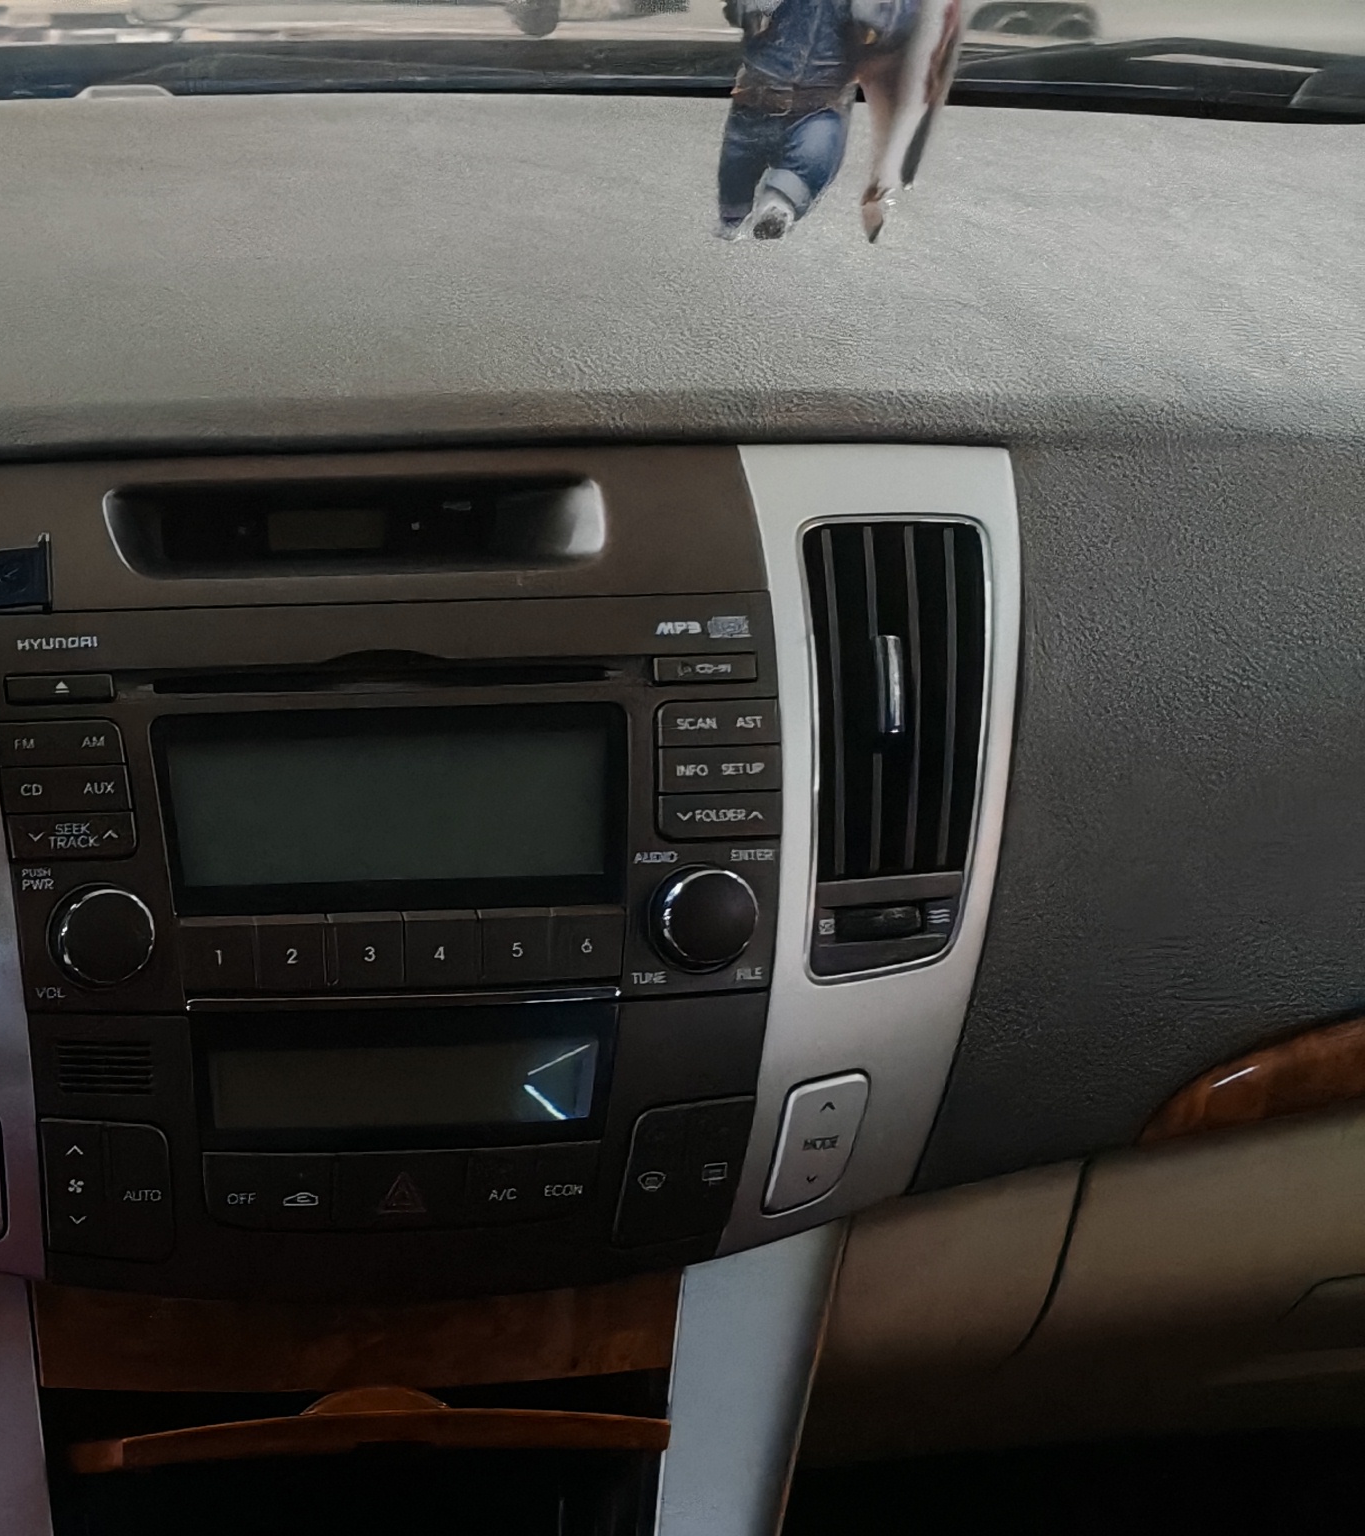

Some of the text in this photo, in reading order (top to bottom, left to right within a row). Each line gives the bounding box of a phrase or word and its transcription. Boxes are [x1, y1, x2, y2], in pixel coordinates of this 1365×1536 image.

[655, 621, 703, 636] MP3
[16, 635, 99, 651] HYUNDAI
[675, 716, 718, 730] SCAN
[735, 715, 763, 729] AST
[13, 737, 36, 750] FM
[80, 735, 106, 748] AM
[675, 764, 709, 777] INFO
[20, 783, 43, 797] CD
[82, 781, 115, 795] AUX
[694, 808, 746, 822] FOLDER
[54, 822, 91, 835] SEEK
[48, 835, 101, 850] TRACK
[21, 867, 52, 878] PUSH
[21, 878, 55, 891] PWR
[511, 941, 524, 958] 5
[580, 938, 593, 954] 6
[214, 949, 223, 966] 1
[286, 948, 298, 965] 2
[363, 946, 376, 963] 3
[433, 946, 446, 962] 4
[631, 971, 667, 985] TUNE
[35, 986, 67, 999] VOL
[123, 1189, 162, 1202] AUTO
[487, 1186, 517, 1202] A/C
[543, 1183, 584, 1198] ECON
[226, 1192, 257, 1206] OFF
